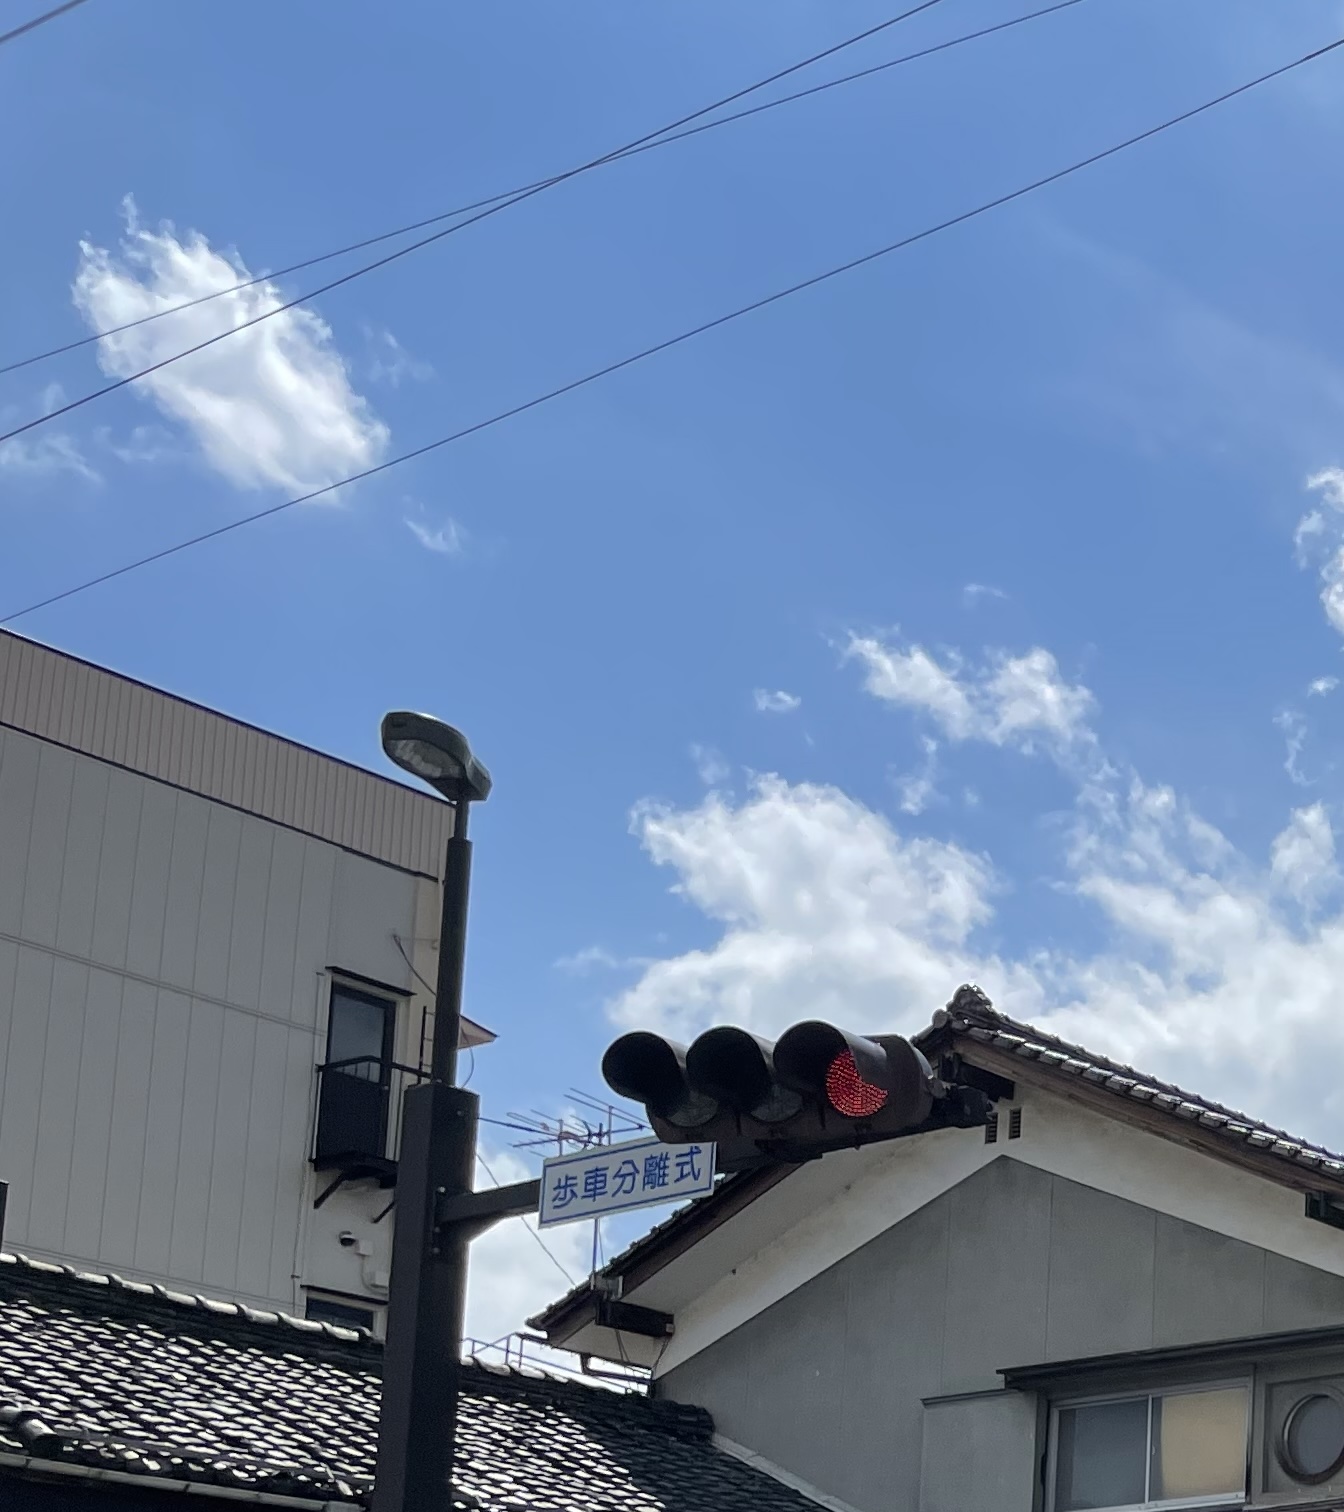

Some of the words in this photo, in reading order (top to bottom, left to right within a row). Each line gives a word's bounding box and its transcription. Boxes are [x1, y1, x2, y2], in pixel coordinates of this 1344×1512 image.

[552, 1145, 702, 1209] 歩車分離式
